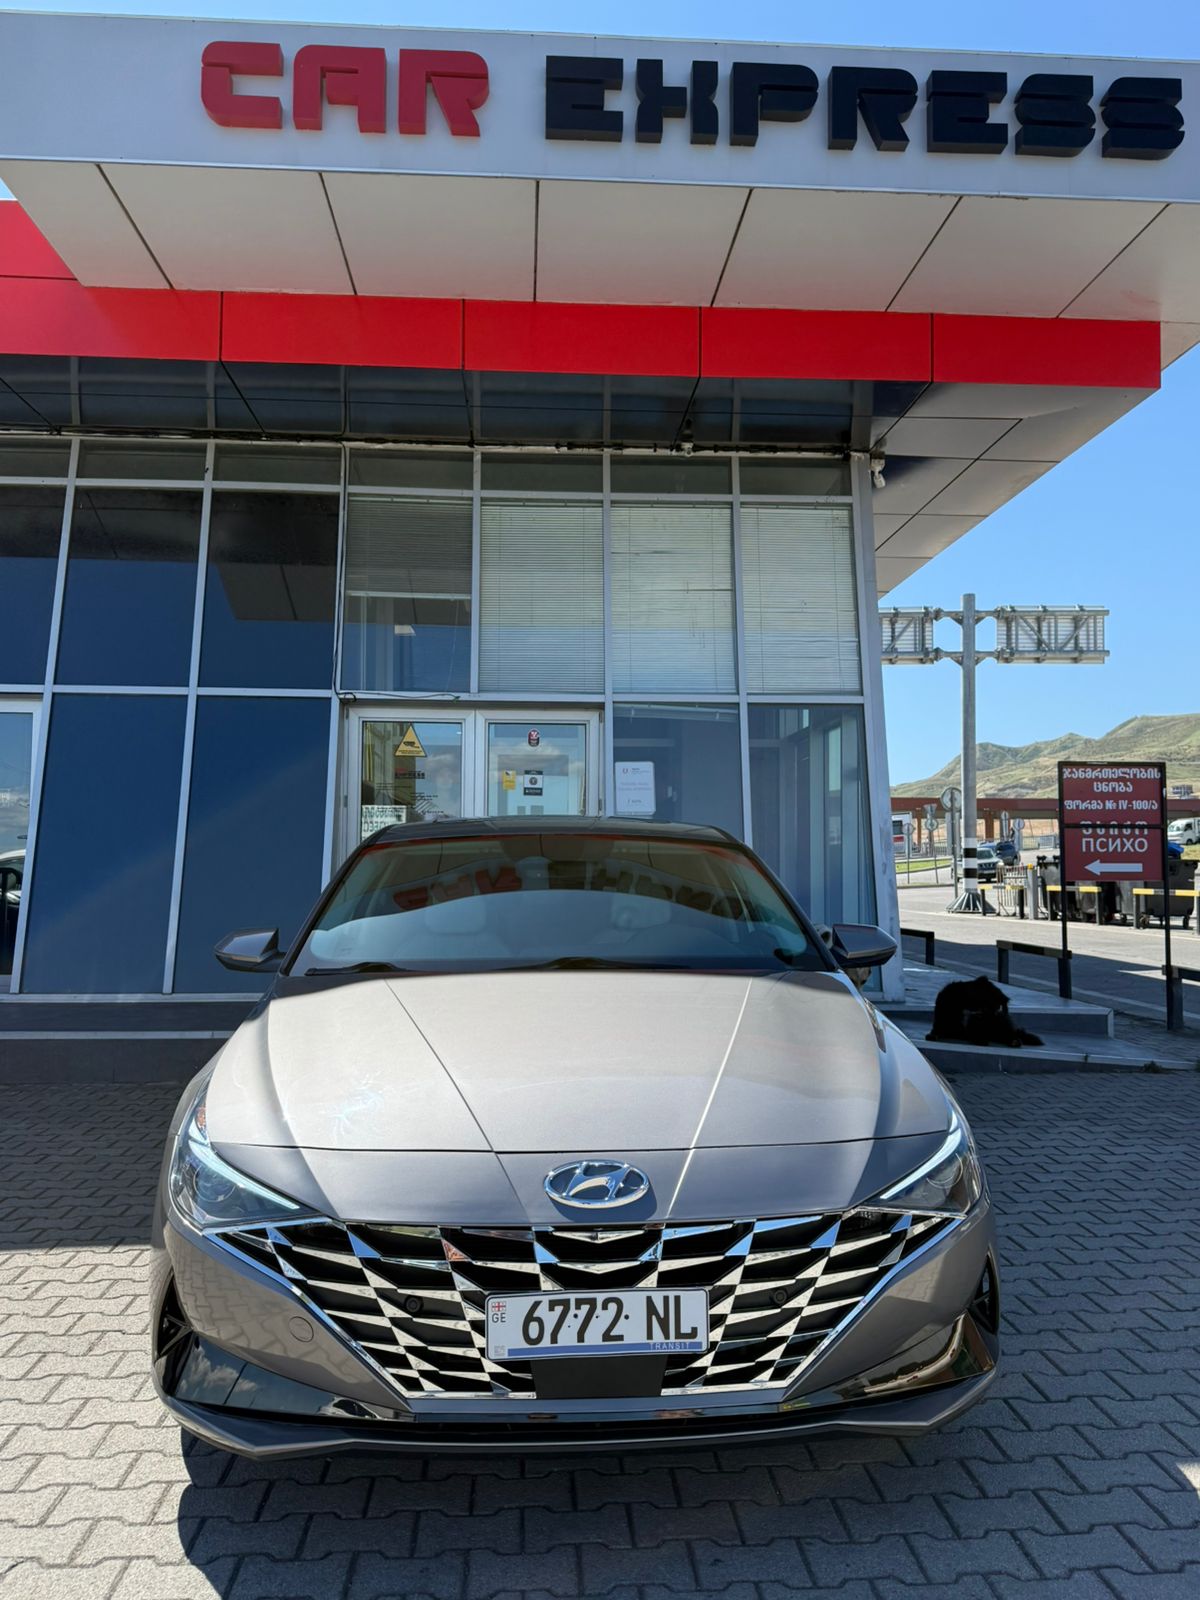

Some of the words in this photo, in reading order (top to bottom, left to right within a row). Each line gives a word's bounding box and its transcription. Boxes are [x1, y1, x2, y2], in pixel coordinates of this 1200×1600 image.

[201, 40, 490, 138] CAR
[545, 55, 1186, 160] EXPRESS
[1062, 767, 1161, 779] ჯანმრთელობის
[1093, 781, 1133, 793] ცნობა
[1064, 799, 1103, 810] ფორმა
[1081, 837, 1149, 853] ПСИХО
[491, 1312, 506, 1323] GE
[521, 1296, 625, 1346] 6772
[646, 1295, 698, 1341] NL
[650, 1341, 690, 1351] TRANSIT
